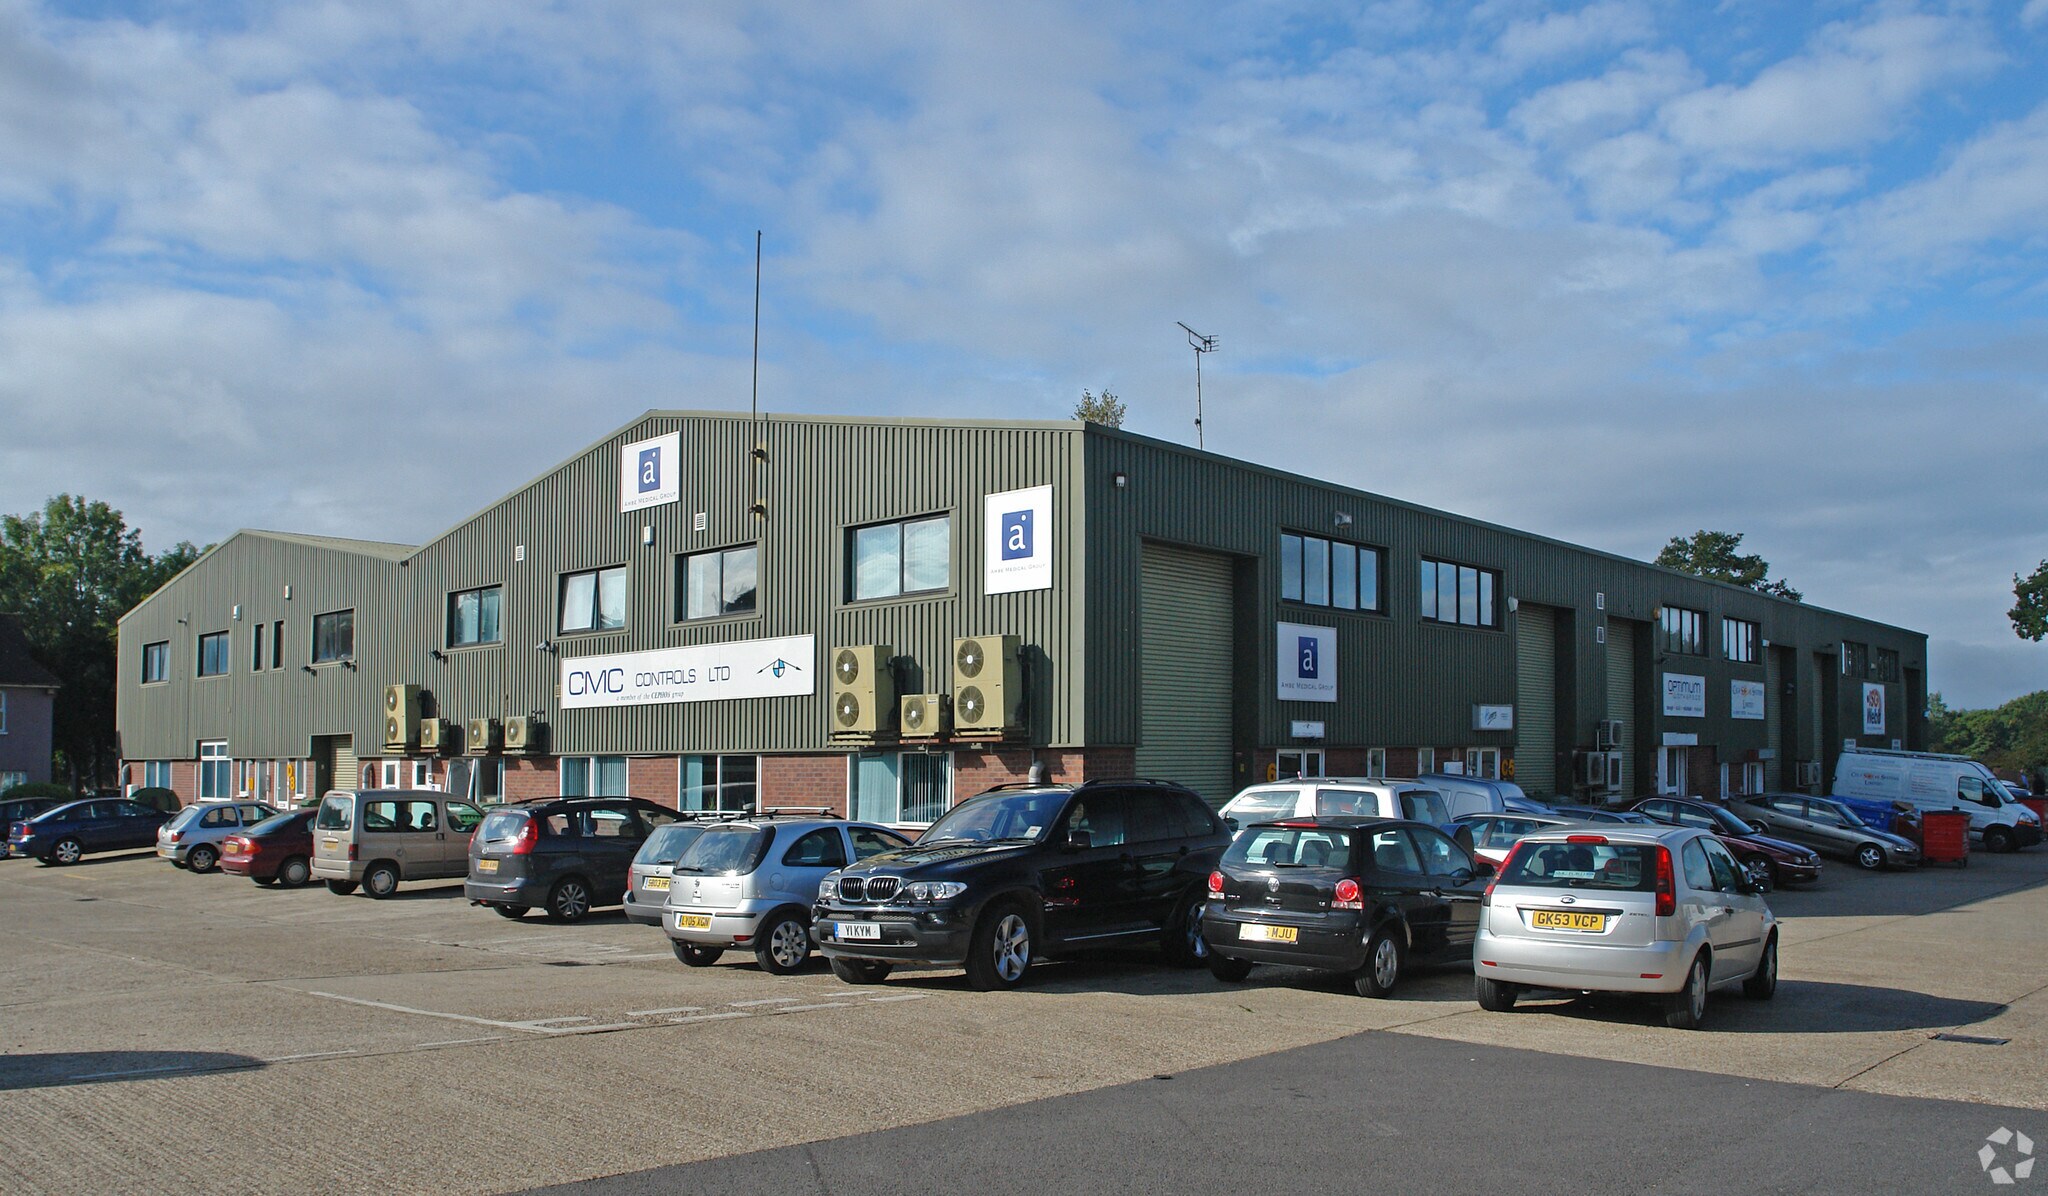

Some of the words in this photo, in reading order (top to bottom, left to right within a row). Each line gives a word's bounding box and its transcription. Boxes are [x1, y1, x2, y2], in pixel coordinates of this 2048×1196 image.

[638, 495, 658, 503] MEDICAL
[660, 491, 676, 499] GROUP
[1005, 565, 1026, 573] MEDICAL
[568, 668, 624, 696] CMC
[635, 668, 697, 688] CONTROLS
[708, 665, 731, 682] LTD
[1296, 682, 1317, 690] MEDICAL
[1318, 683, 1334, 691] GROUP
[672, 691, 684, 699] group
[1502, 759, 1515, 776] C5
[1537, 912, 1570, 926] GK53
[1573, 915, 1598, 928] VCP
[1271, 927, 1293, 939] MJU
